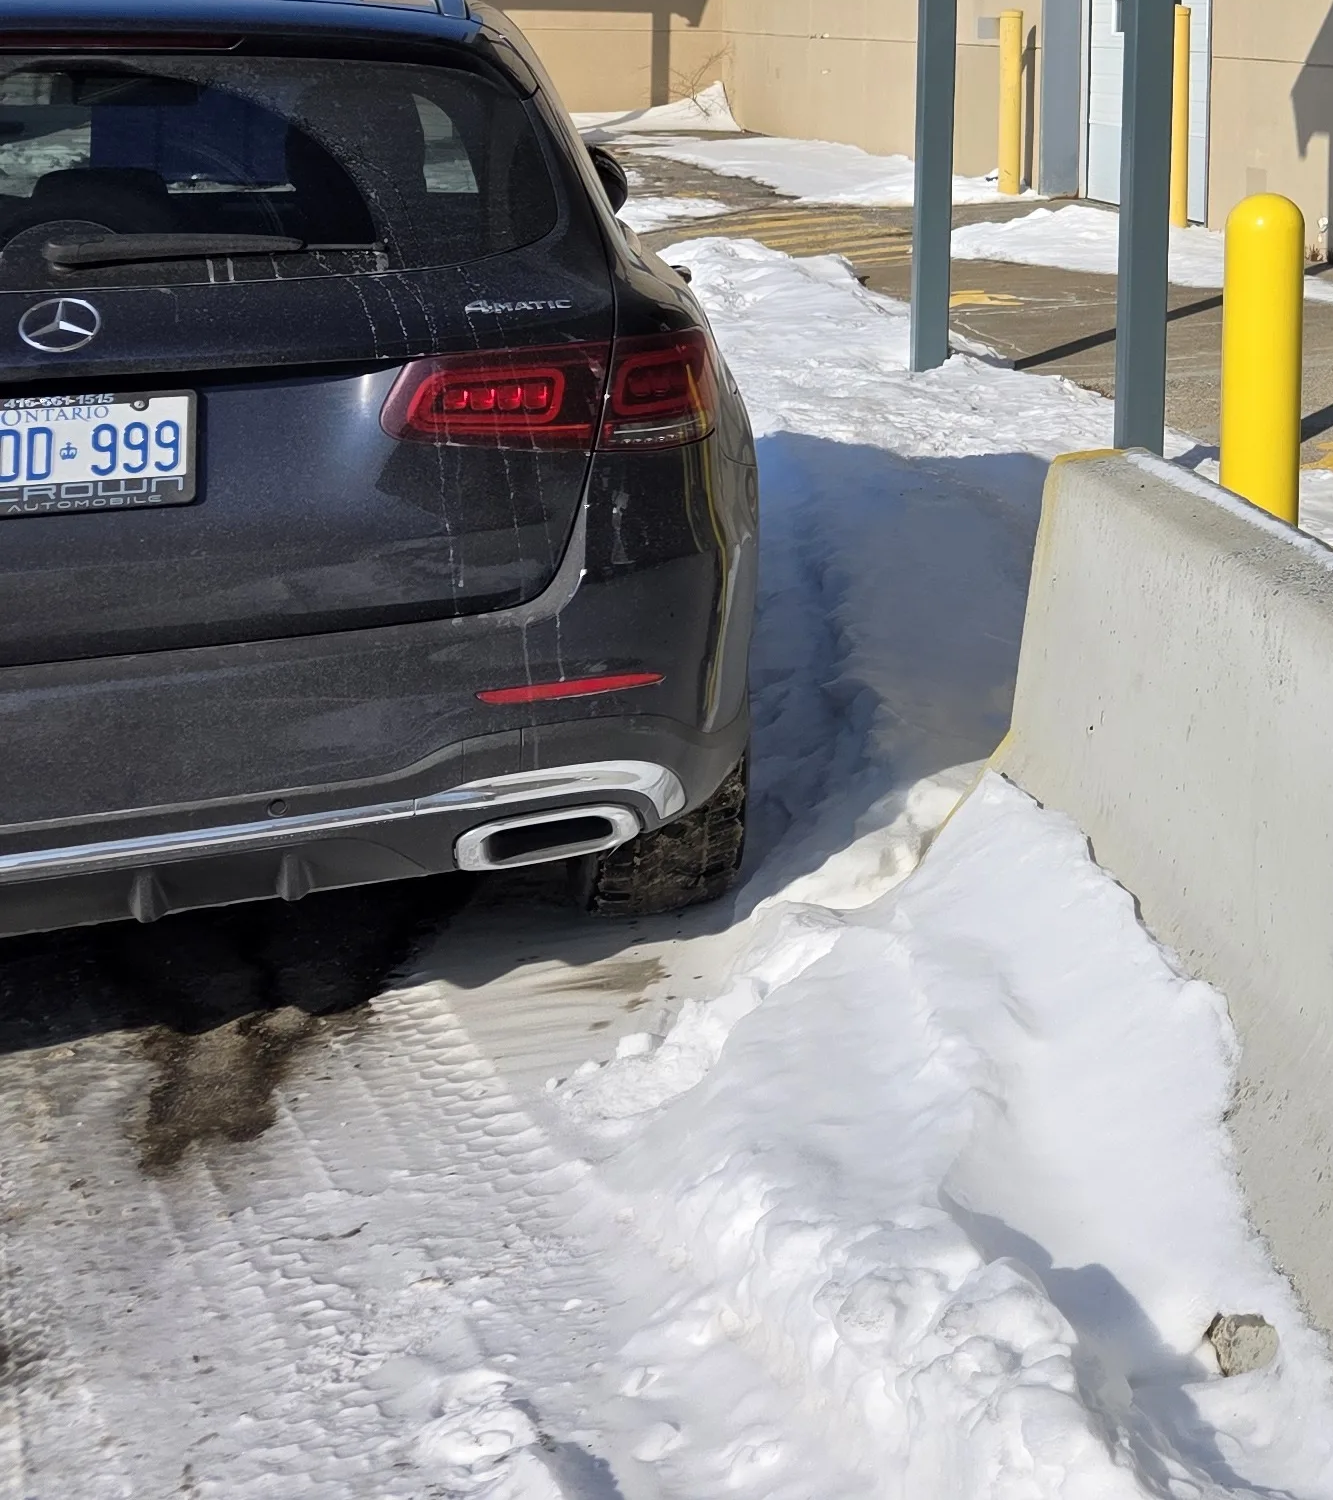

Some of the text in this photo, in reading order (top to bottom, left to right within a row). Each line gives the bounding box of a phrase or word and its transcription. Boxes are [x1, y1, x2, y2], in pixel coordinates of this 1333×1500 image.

[465, 299, 573, 314] 4MATIC
[1, 406, 109, 426] ONTARIO
[91, 420, 180, 476] 999
[8, 494, 162, 513] AUTOMOBILE
